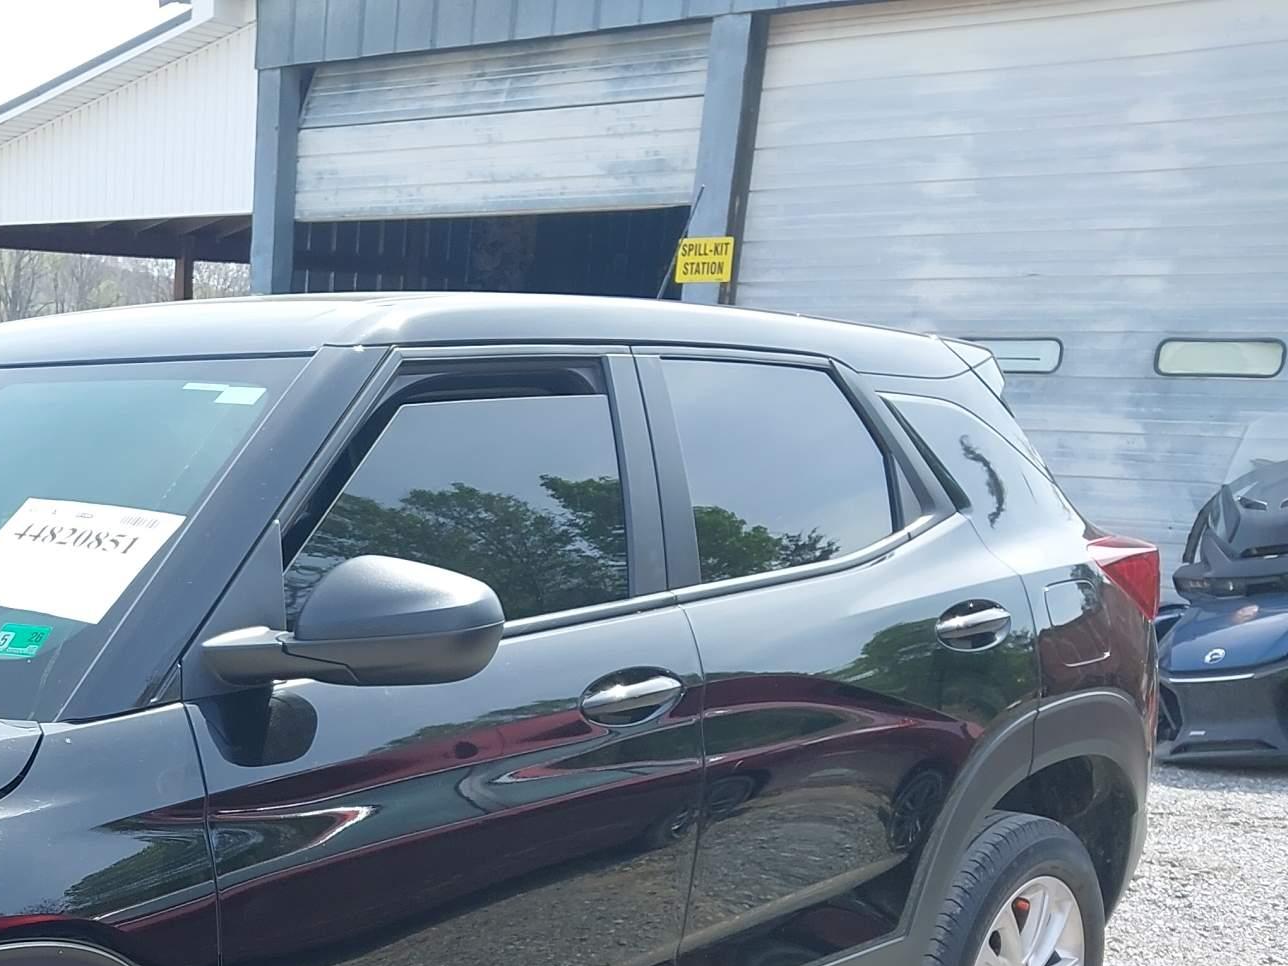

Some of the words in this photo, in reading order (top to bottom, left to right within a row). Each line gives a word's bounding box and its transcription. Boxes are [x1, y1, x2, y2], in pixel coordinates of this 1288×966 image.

[681, 243, 730, 256] SPILL-KIT
[682, 261, 725, 276] STATION
[14, 523, 139, 554] 44820851
